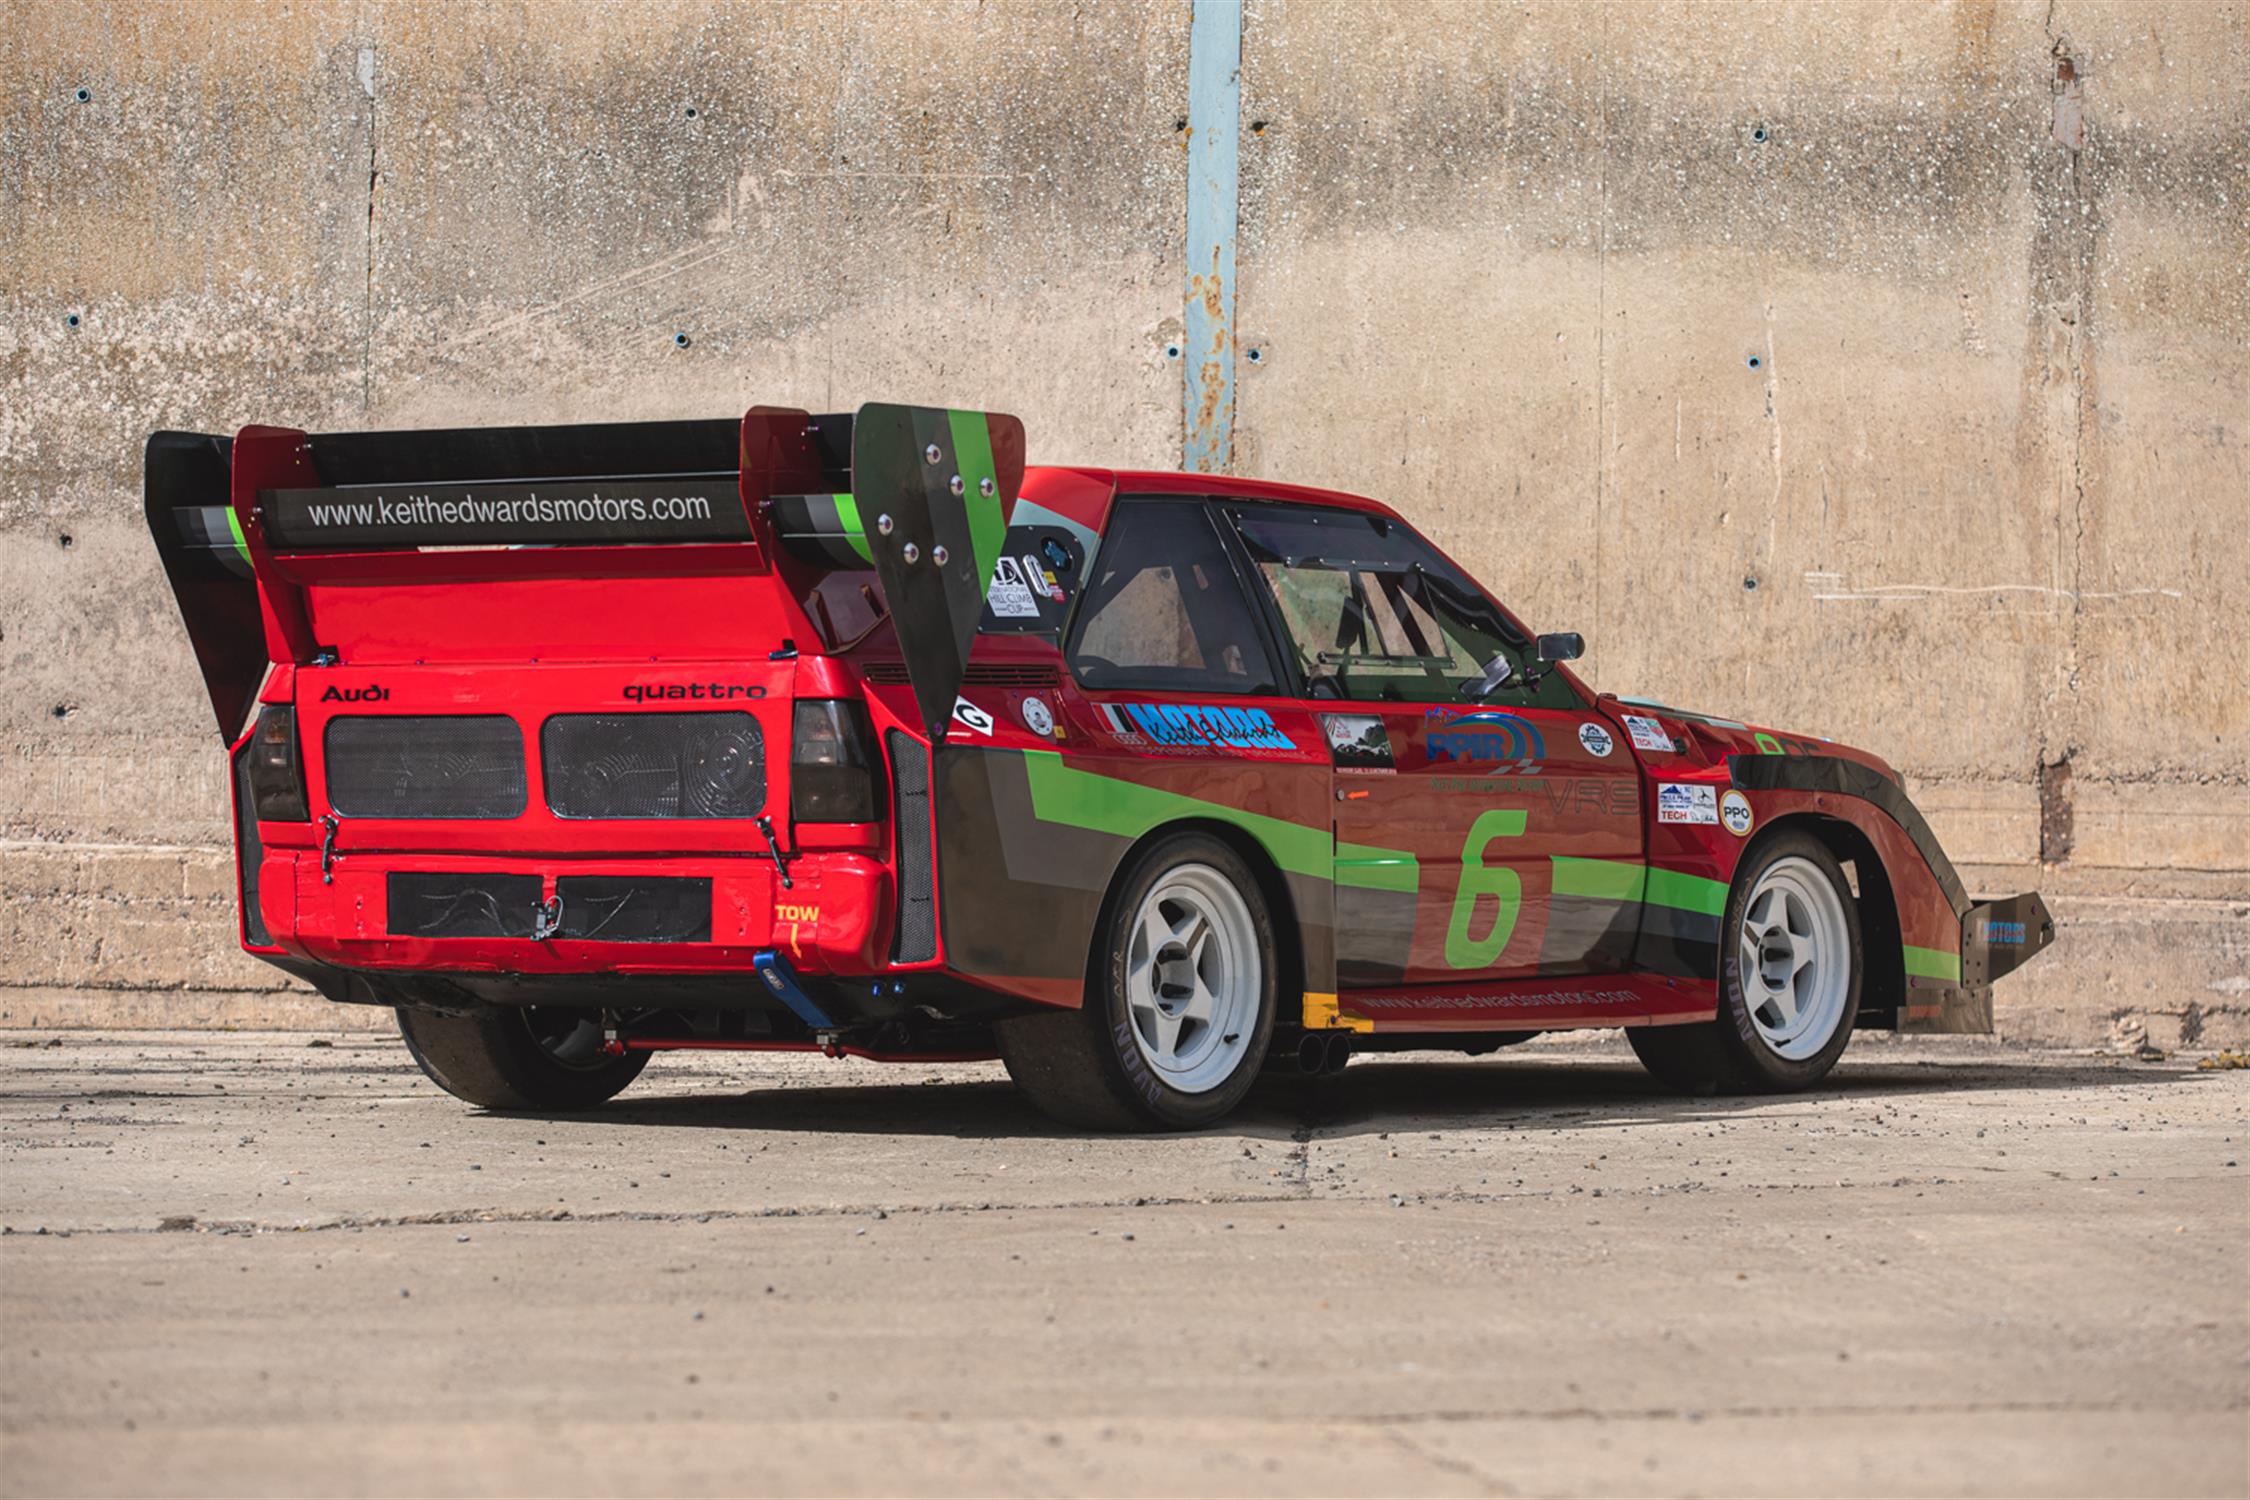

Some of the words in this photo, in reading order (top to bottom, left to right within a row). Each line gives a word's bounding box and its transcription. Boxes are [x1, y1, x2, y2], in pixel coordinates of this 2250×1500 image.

[308, 494, 710, 526] www.keithedwardsmotors.com
[320, 684, 390, 703] Audi
[623, 682, 767, 703] quattro
[956, 704, 989, 728] G
[1124, 704, 1296, 749] MOTORS
[1426, 733, 1505, 760] PPIR
[1662, 810, 1688, 820] TECH
[1724, 806, 1750, 820] PPO
[1444, 809, 1528, 970] 6
[775, 905, 819, 921] TOW
